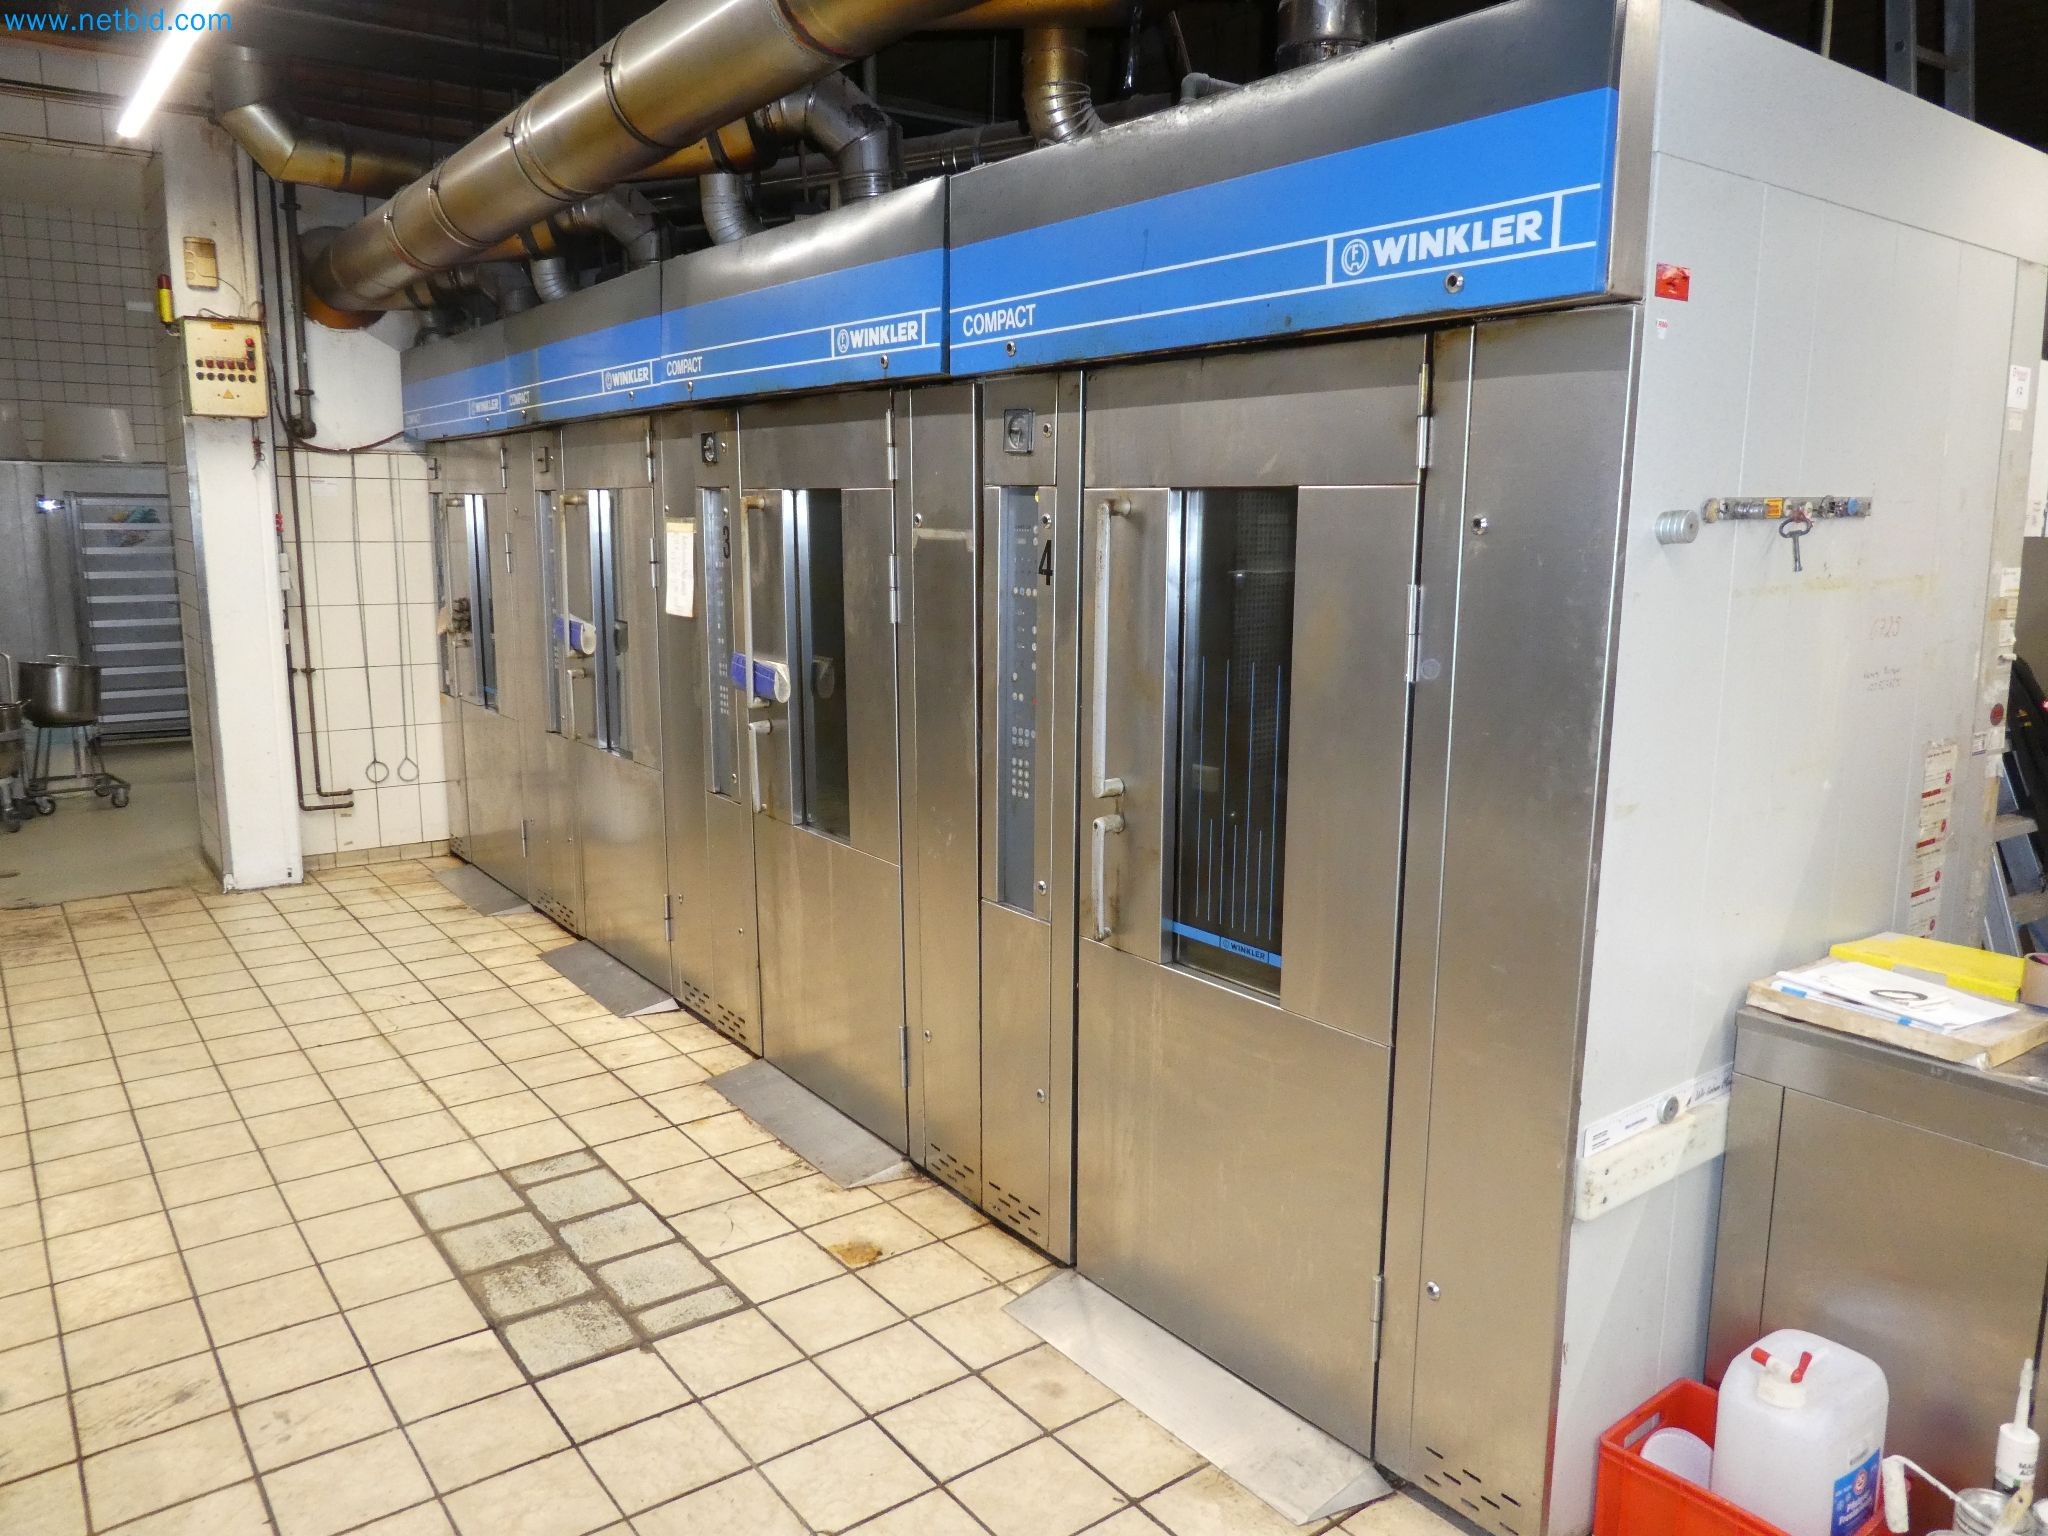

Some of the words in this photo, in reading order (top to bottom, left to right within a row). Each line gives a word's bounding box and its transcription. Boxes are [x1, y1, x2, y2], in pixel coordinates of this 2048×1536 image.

[1372, 210, 1543, 267] WINKLER
[962, 303, 1036, 337] COMPACT
[849, 320, 919, 349] WINKLER
[611, 366, 649, 389] WINKLER
[666, 356, 703, 378] COMPACT
[475, 398, 499, 413] WINKLER
[509, 391, 531, 405] COMPACT
[723, 526, 731, 559] 3
[1038, 539, 1054, 586] 4
[1230, 942, 1266, 960] WINKLER
